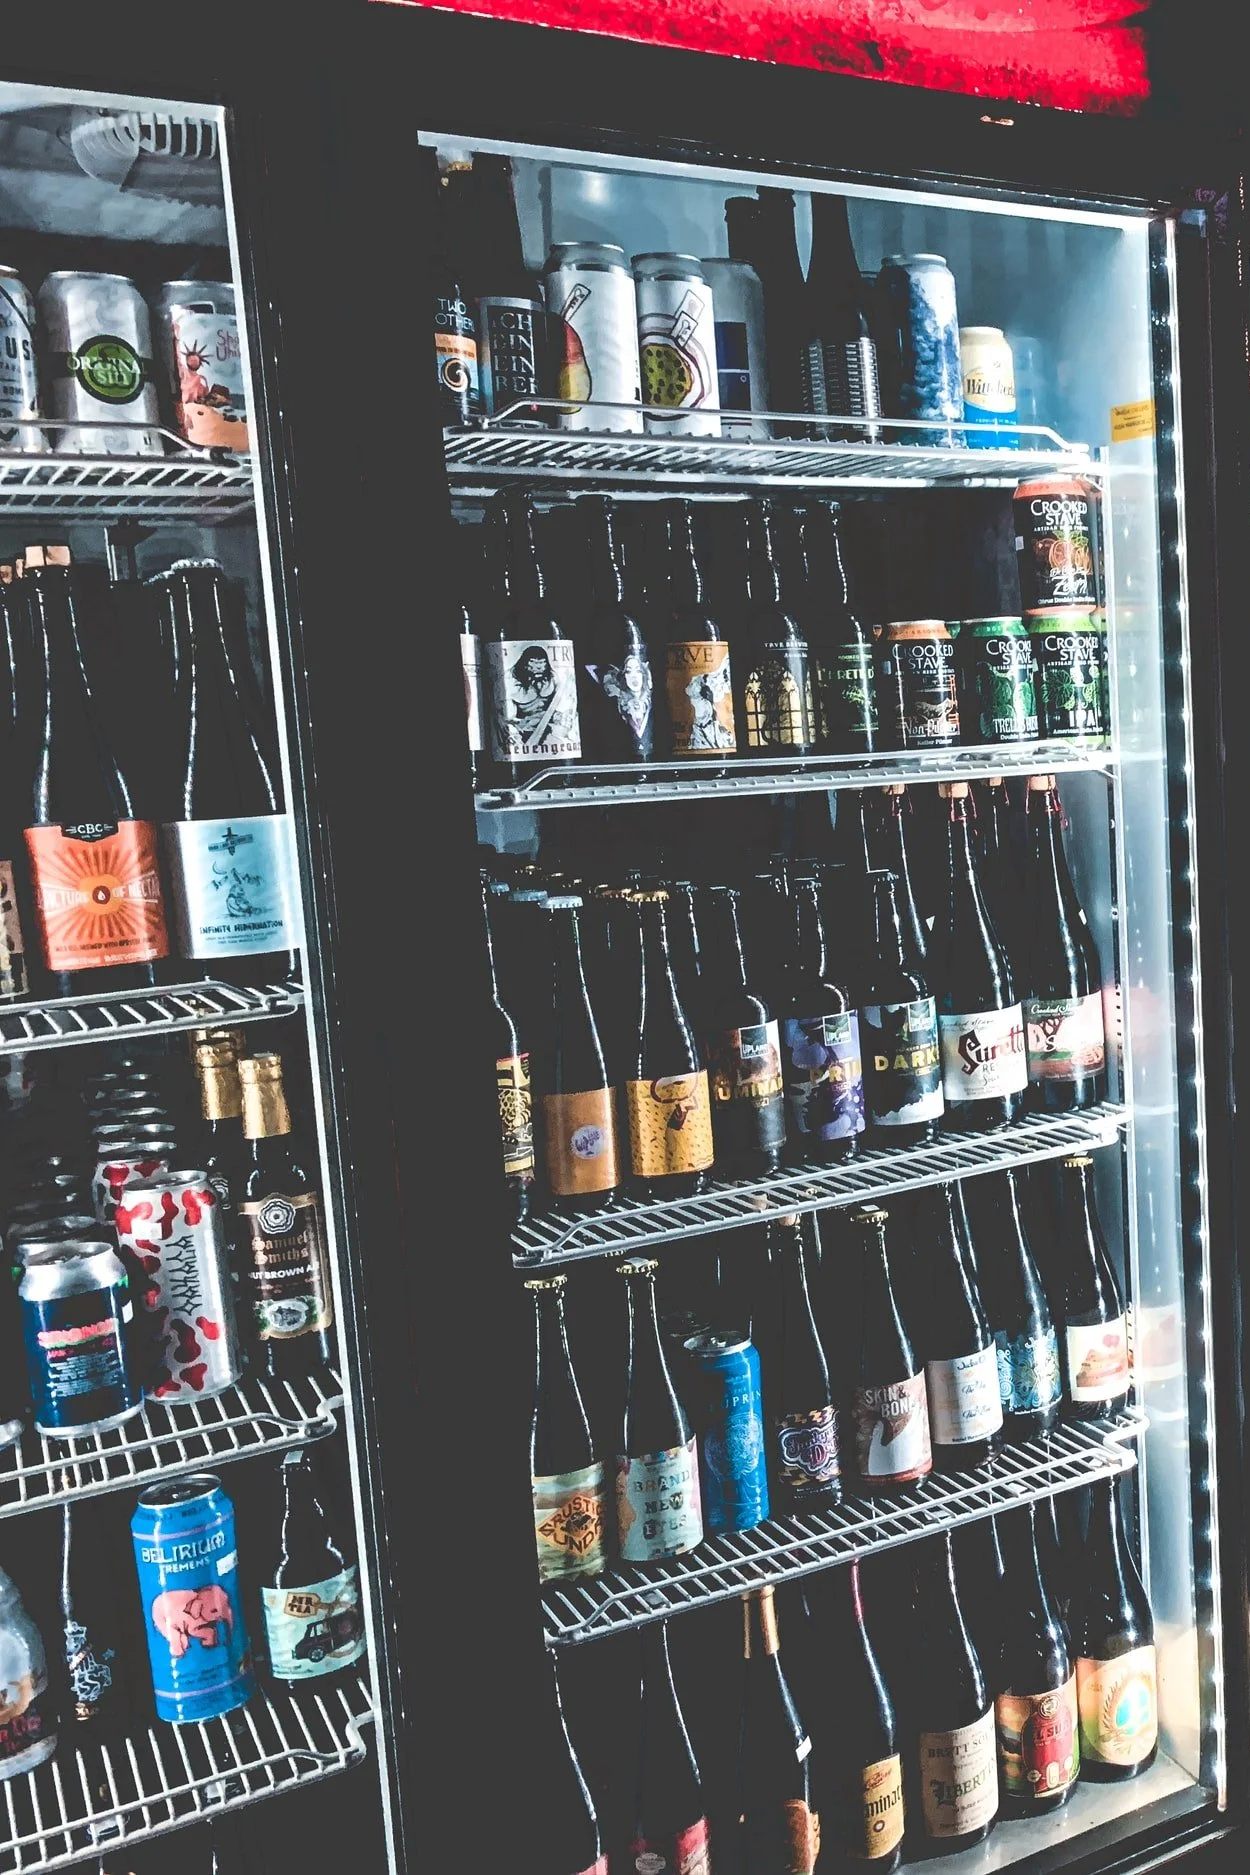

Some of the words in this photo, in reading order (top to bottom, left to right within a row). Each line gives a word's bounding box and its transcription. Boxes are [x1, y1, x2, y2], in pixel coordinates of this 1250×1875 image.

[437, 298, 467, 315] TWO
[434, 313, 475, 333] OTHER
[1030, 499, 1088, 516] CROOKED
[1045, 513, 1083, 526] STAVE
[908, 656, 949, 670] STAVE
[1060, 648, 1097, 661] STAVE
[1068, 708, 1098, 728] IPA
[77, 823, 103, 835] CBC
[874, 1046, 940, 1071] DARK
[264, 1266, 305, 1281] BROWN
[633, 1470, 690, 1493] BRAND
[644, 1491, 684, 1514] NEW
[158, 1556, 211, 1574] TREMENS
[288, 1602, 311, 1614] TEA
